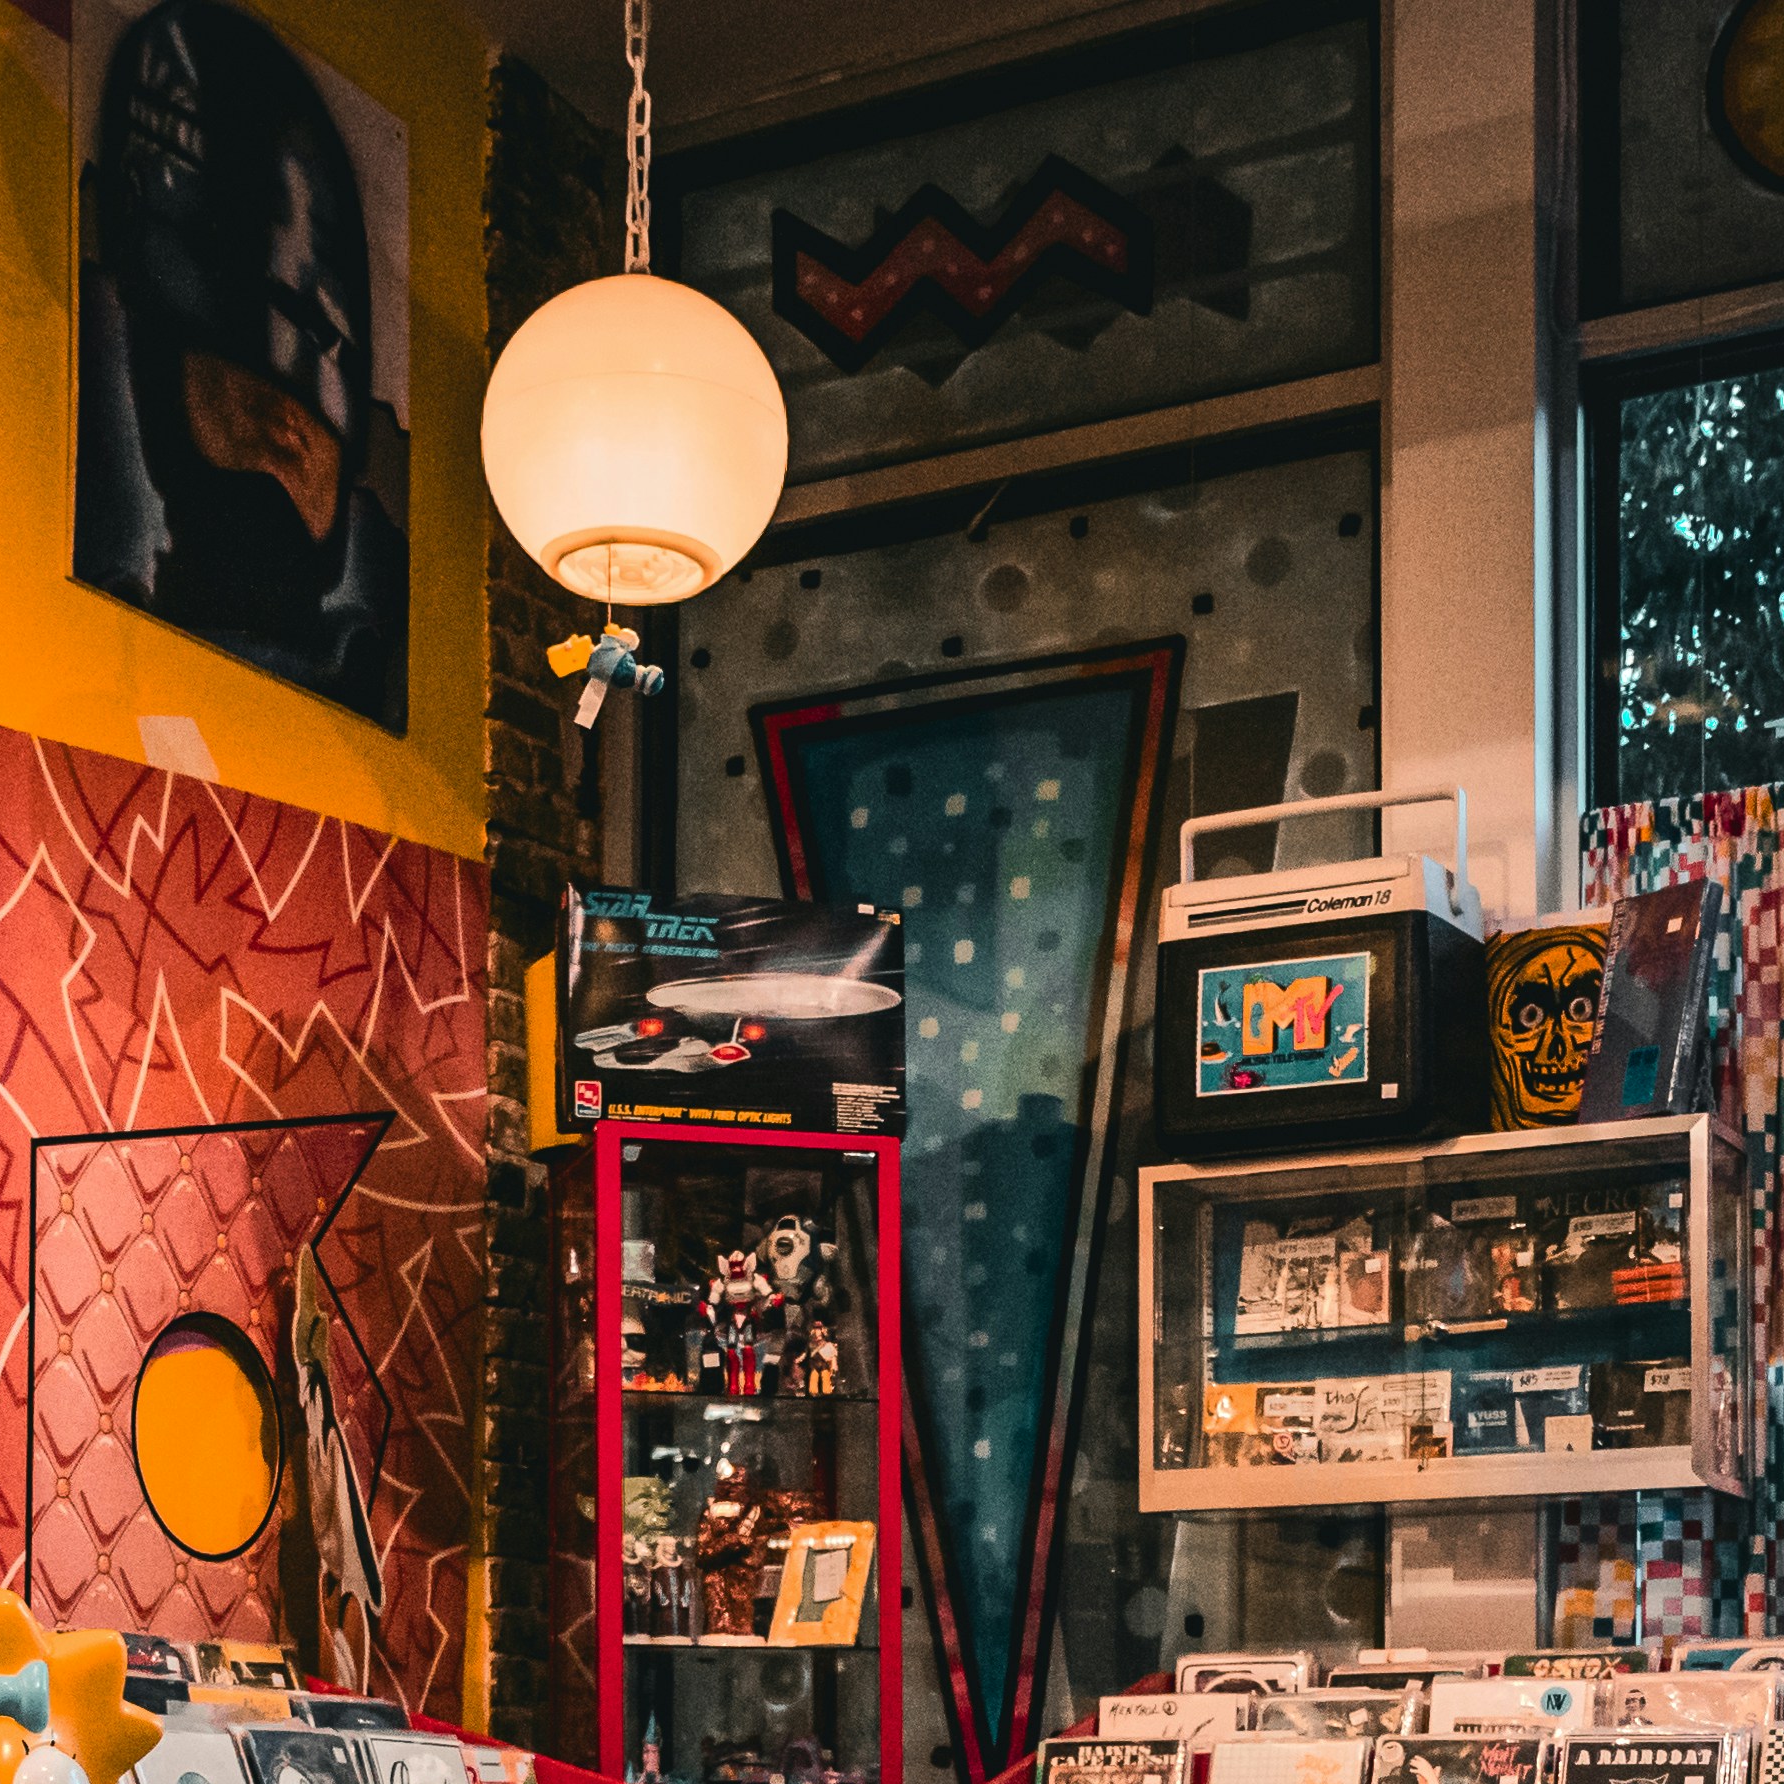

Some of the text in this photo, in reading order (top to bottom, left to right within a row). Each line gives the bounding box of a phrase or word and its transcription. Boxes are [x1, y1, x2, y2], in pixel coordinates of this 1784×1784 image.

[583, 892, 652, 920] STAR
[1306, 888, 1392, 914] Coleman 18
[644, 912, 719, 942] TREK
[1242, 975, 1344, 1056] MTV
